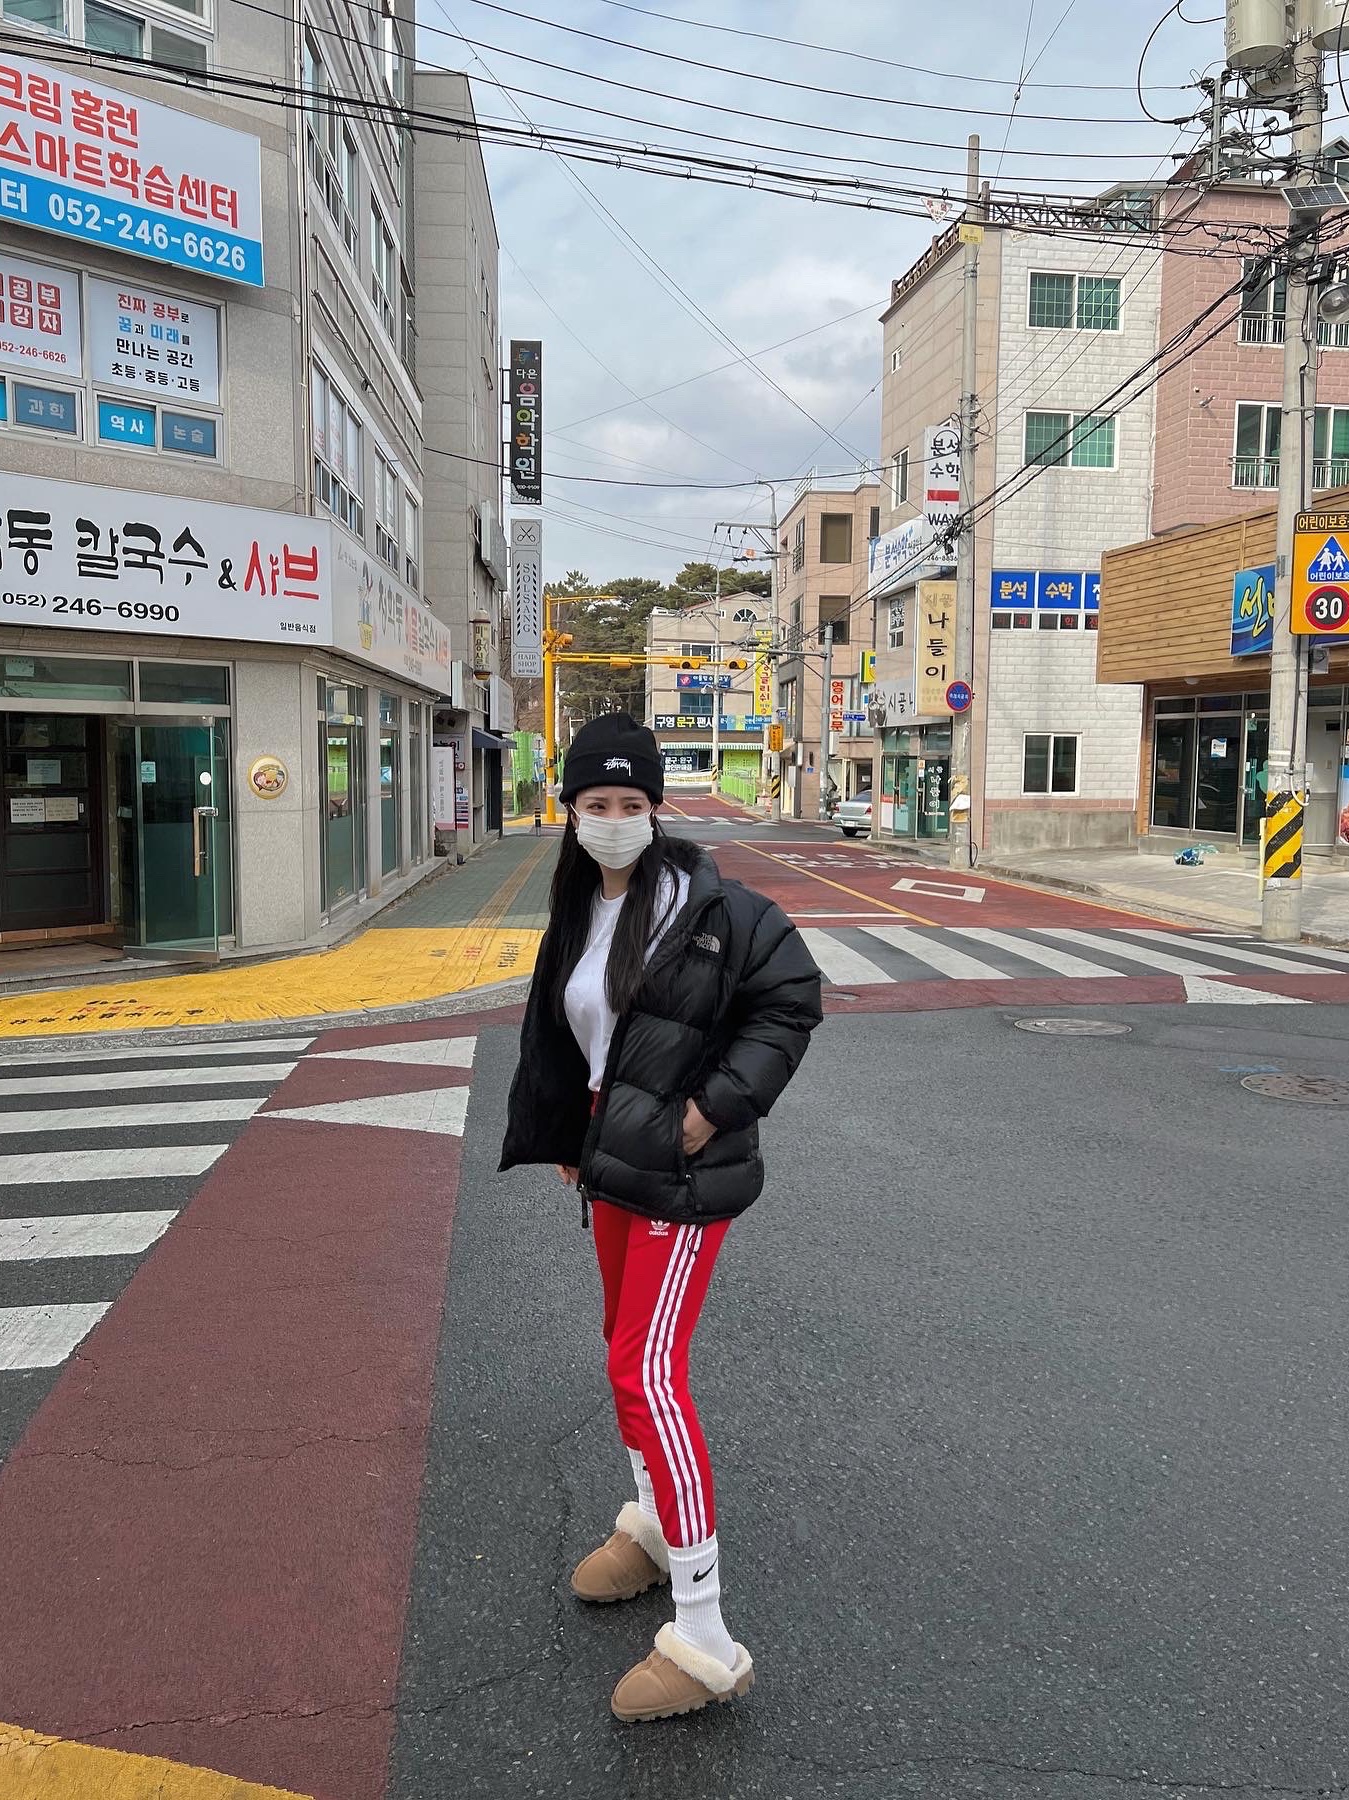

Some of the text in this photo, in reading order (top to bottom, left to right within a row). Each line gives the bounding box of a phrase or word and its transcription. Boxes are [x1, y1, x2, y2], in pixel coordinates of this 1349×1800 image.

[71, 89, 138, 149] 홈런
[0, 121, 238, 229] 스마트학습센터
[48, 193, 246, 271] 052-246-6626
[12, 279, 56, 304] 공부
[13, 305, 58, 331] 강자
[118, 293, 190, 324] 진짜 공부로
[0, 341, 67, 363] 52-246-6626
[116, 338, 194, 368] 만나는 공간
[28, 399, 65, 418] 과학
[110, 415, 144, 435] 역사
[516, 382, 540, 480] 음악학원
[930, 462, 959, 482] 수학
[1299, 514, 1349, 530] 어린이보호
[0, 509, 52, 575] 동
[75, 517, 209, 586] 칼국수
[218, 558, 238, 591] &
[244, 541, 319, 600] 샤브
[522, 563, 531, 633] SOLSANG
[999, 580, 1028, 600] 분석
[1045, 582, 1075, 601] 수학
[52, 596, 181, 622] 246-6990
[1315, 597, 1343, 619] 30
[279, 621, 317, 634] 일반음식점
[925, 612, 949, 681] 나들이
[656, 716, 675, 728] 구영
[676, 716, 696, 728] 문구
